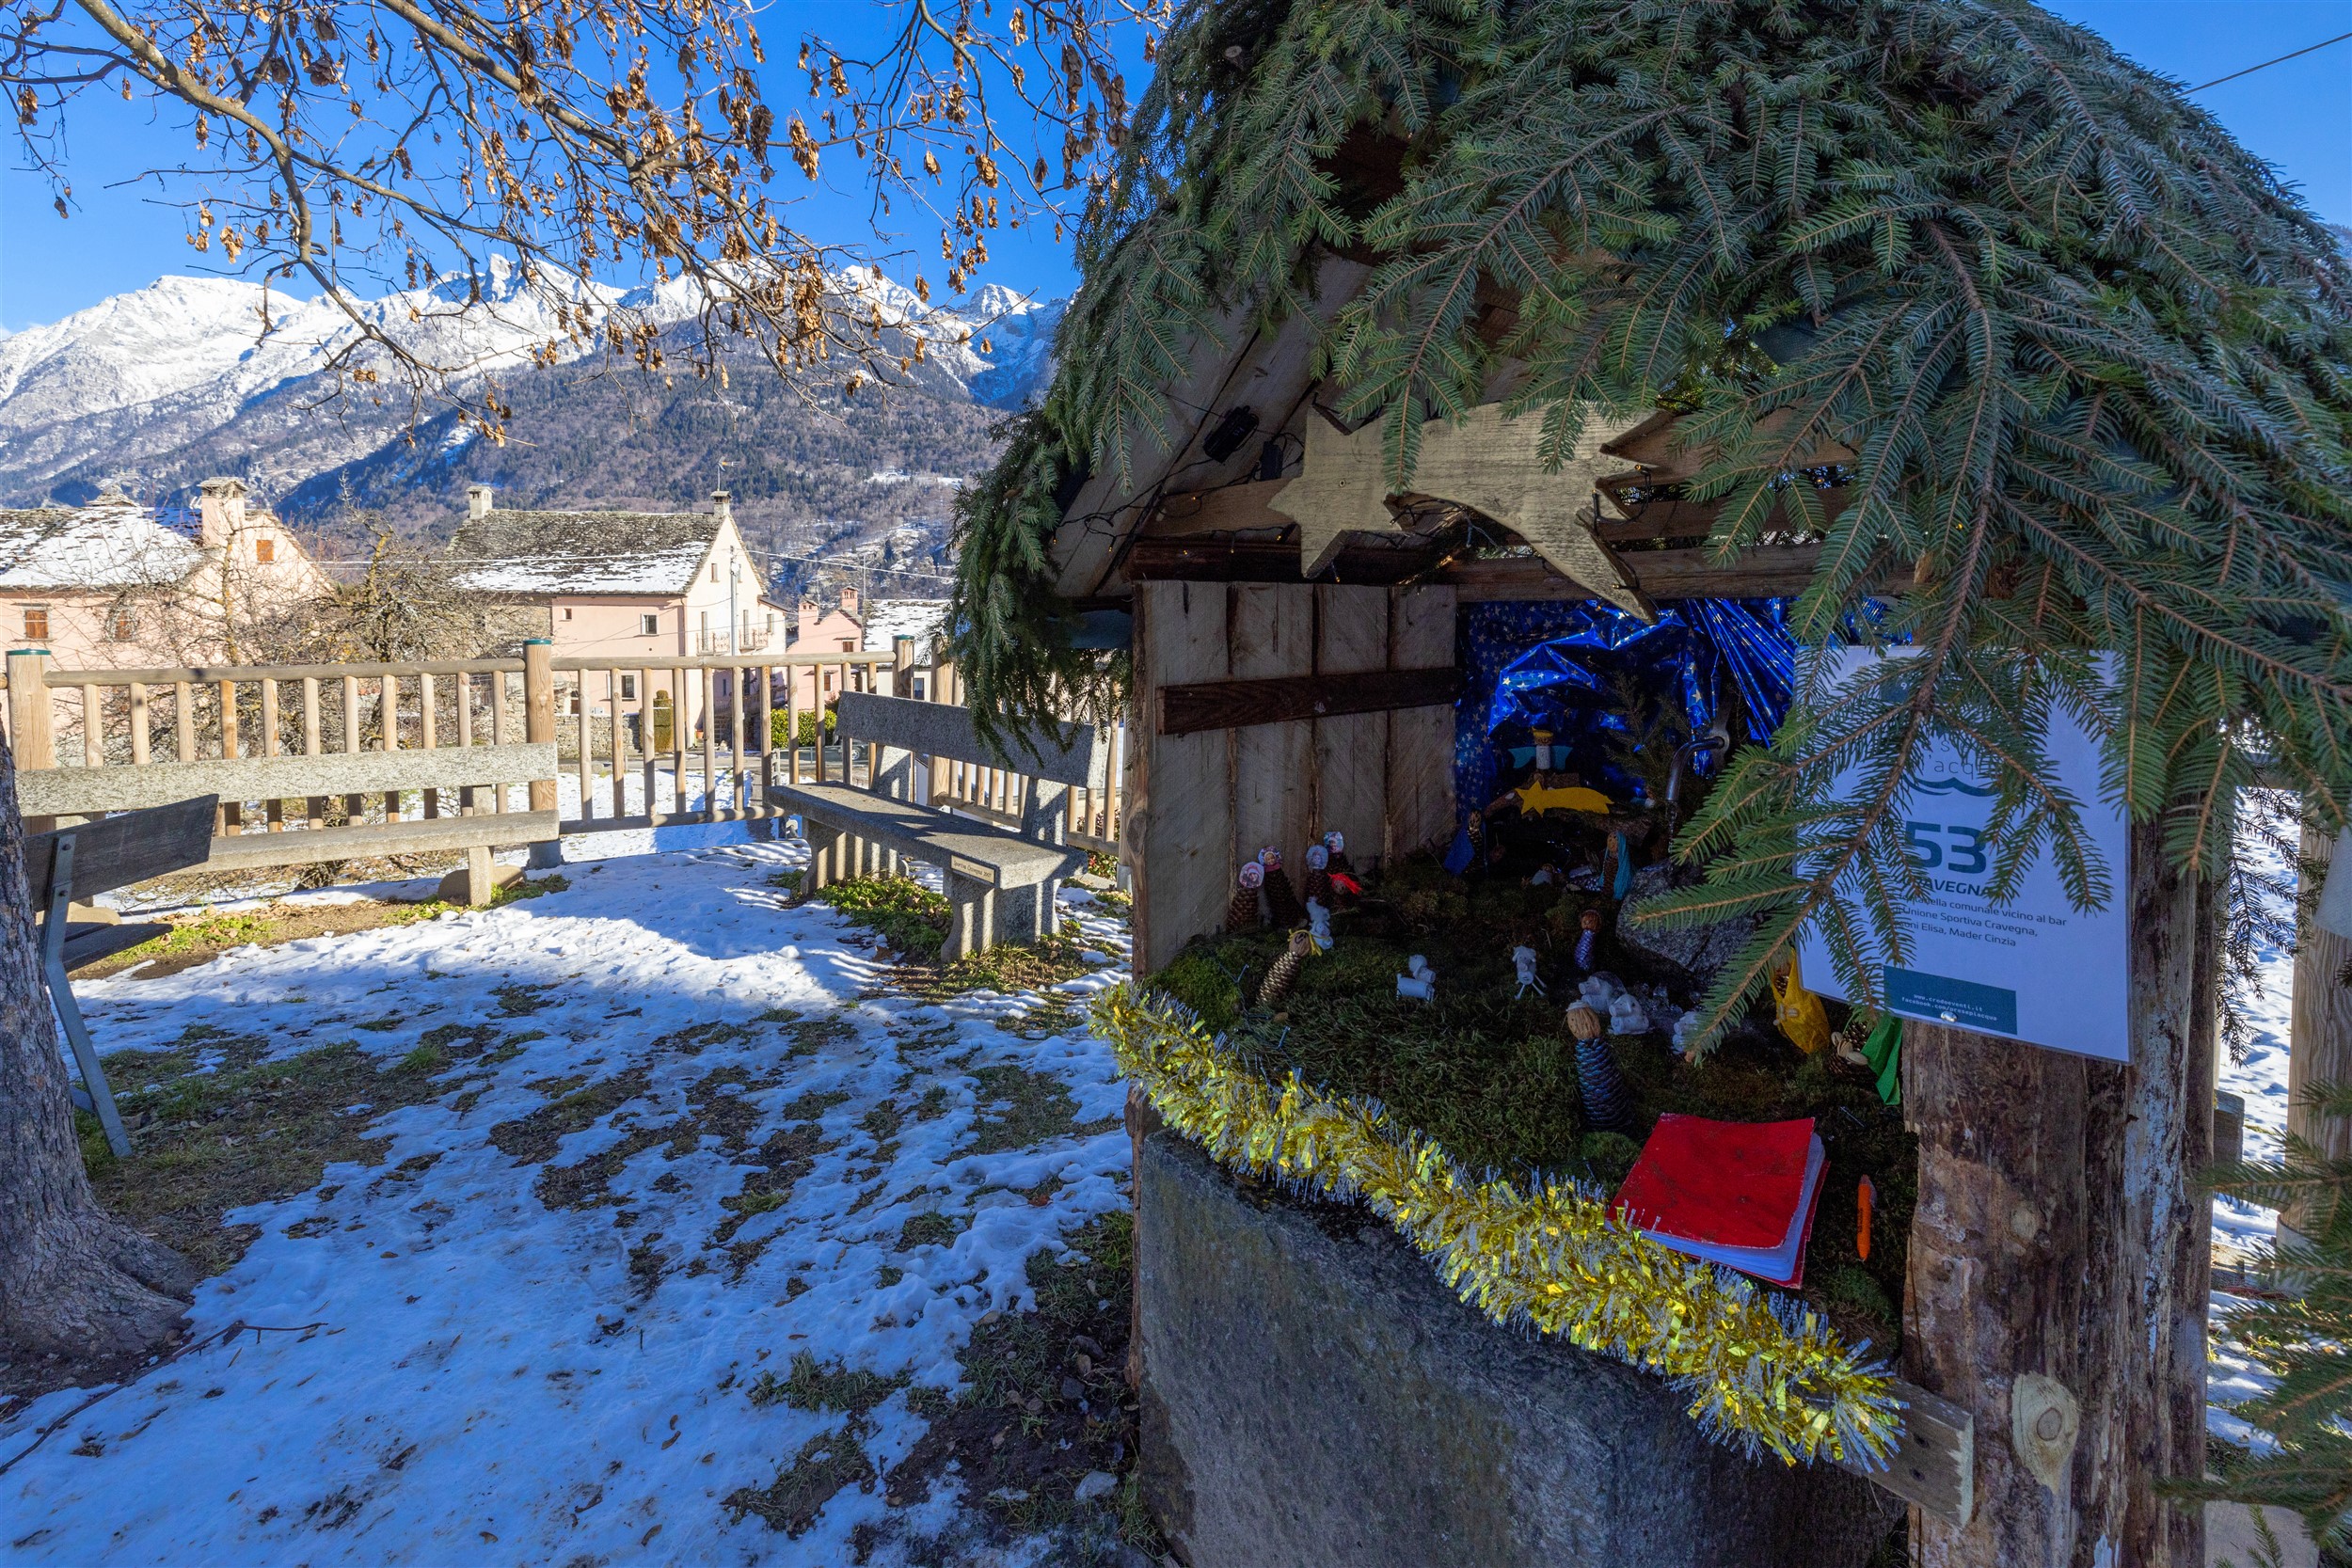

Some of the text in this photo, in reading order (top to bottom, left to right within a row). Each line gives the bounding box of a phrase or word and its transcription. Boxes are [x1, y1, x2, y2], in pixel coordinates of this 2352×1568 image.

[1905, 821, 1987, 874] 53
[1902, 907, 1938, 919] Unione
[1940, 912, 1982, 927] Sportiva
[1984, 920, 2039, 937] Cravegna,
[1949, 901, 2000, 915] comunale
[2002, 909, 2034, 921] vicino
[2048, 915, 2068, 926] bar
[1921, 923, 1947, 935] Elisa,
[1949, 927, 1983, 940] Mader
[1984, 933, 2016, 946] Cinzia
